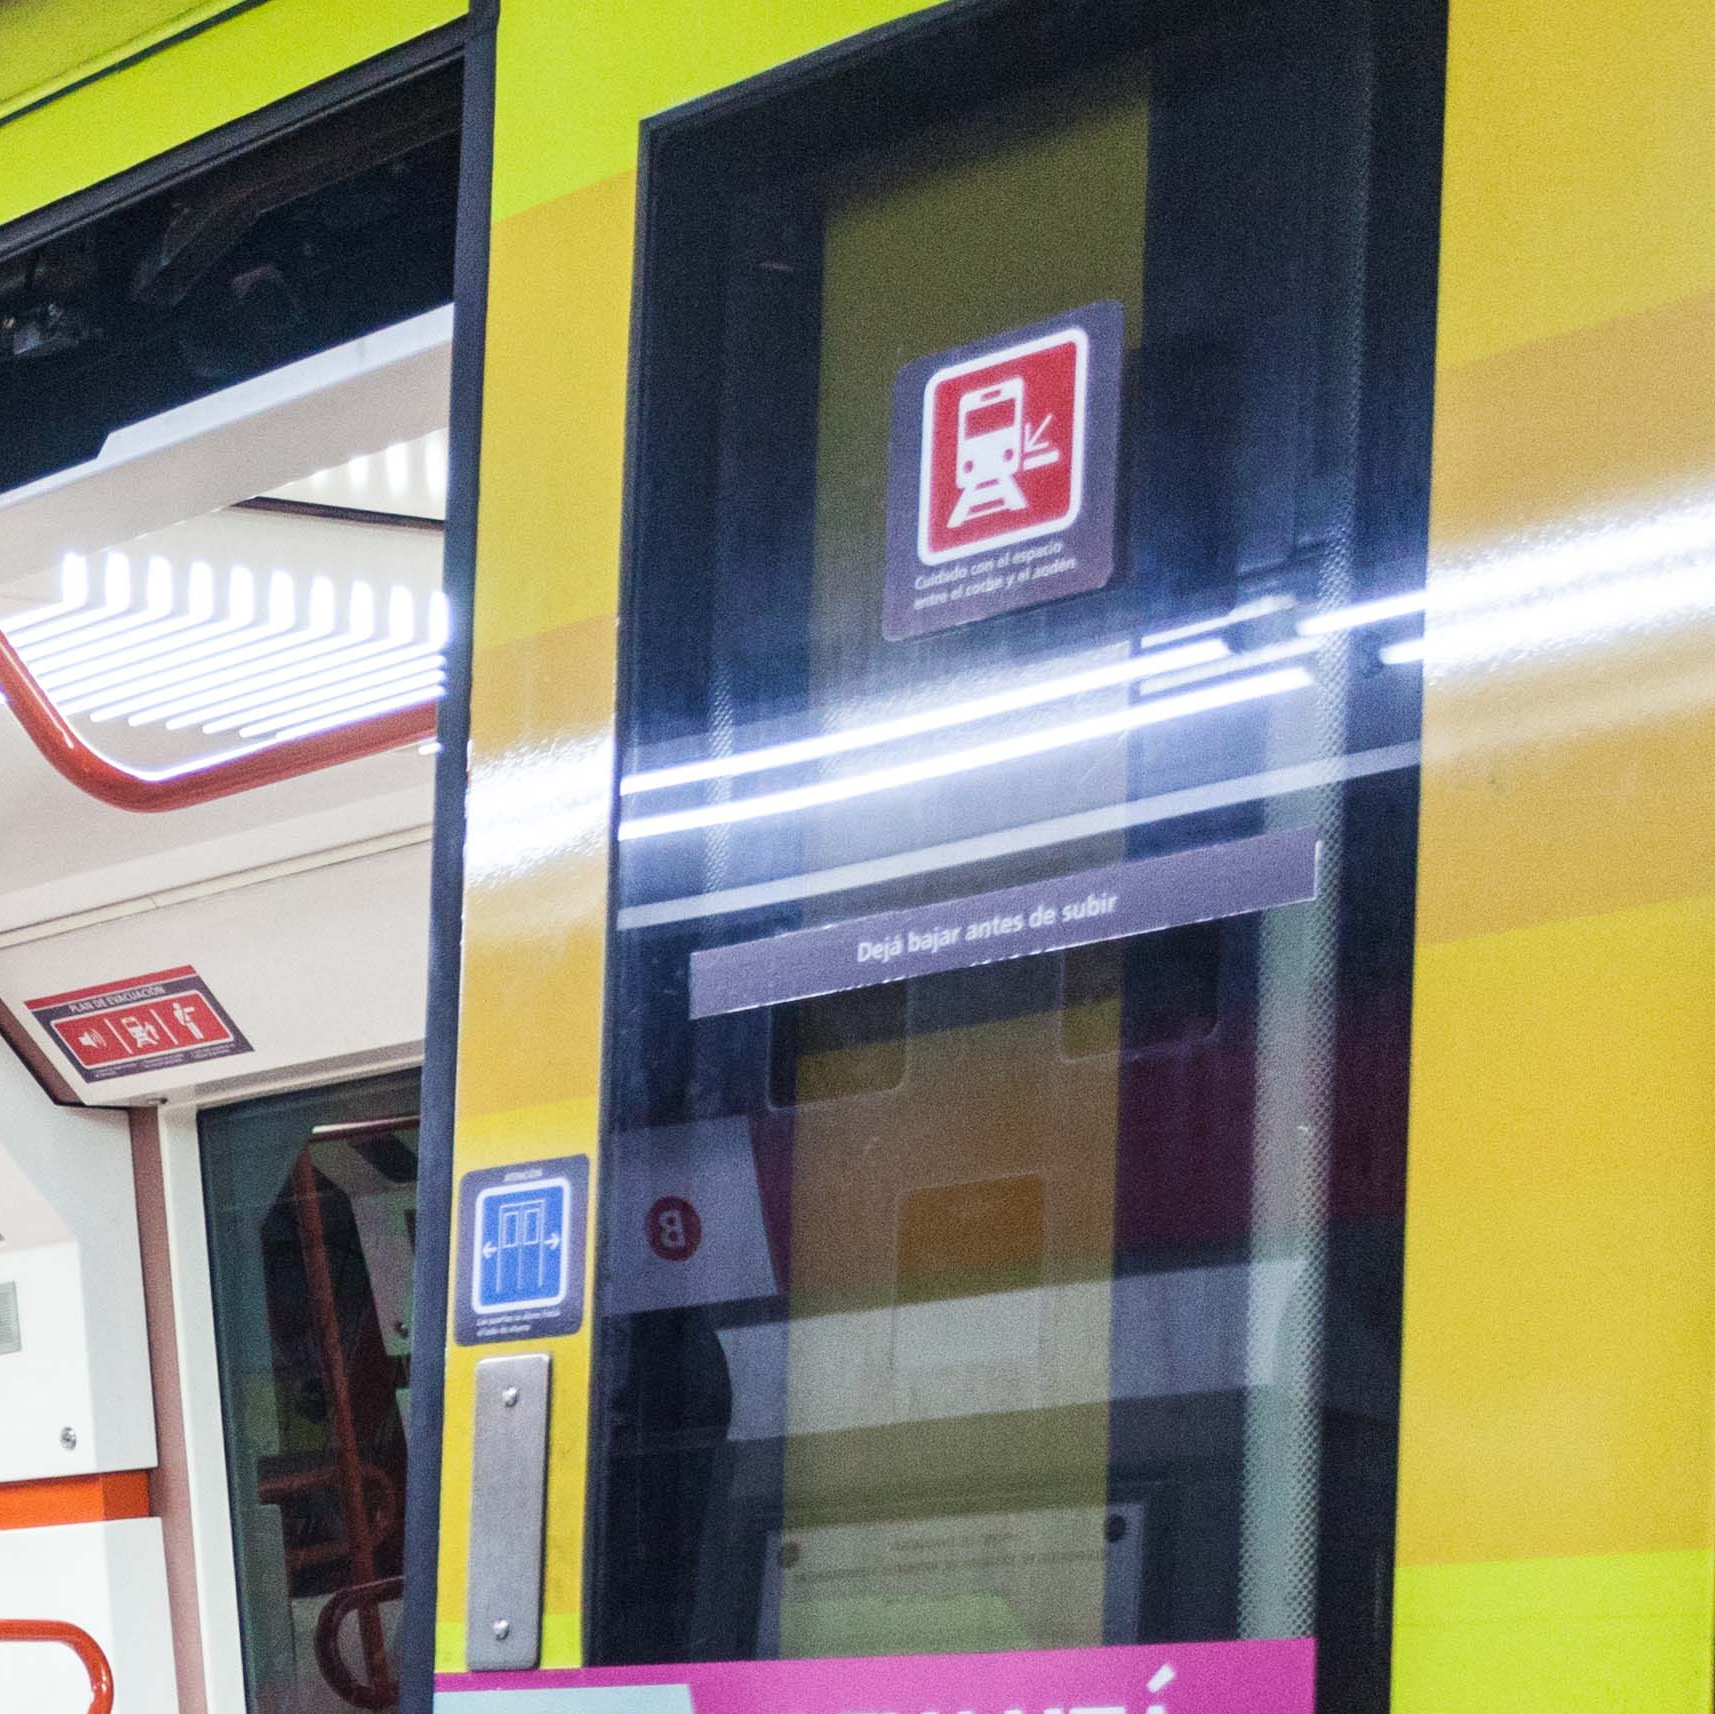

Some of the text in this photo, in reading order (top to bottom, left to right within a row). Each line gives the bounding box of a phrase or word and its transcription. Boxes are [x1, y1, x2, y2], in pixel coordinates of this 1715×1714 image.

[914, 591, 948, 610] entre
[950, 585, 964, 600] el
[966, 574, 1004, 595] coche
[1005, 573, 1017, 589] y
[1018, 567, 1031, 583] el
[915, 542, 1064, 590] Cuidado con el espacio
[857, 891, 1119, 963] Dejá bajar antes de subir
